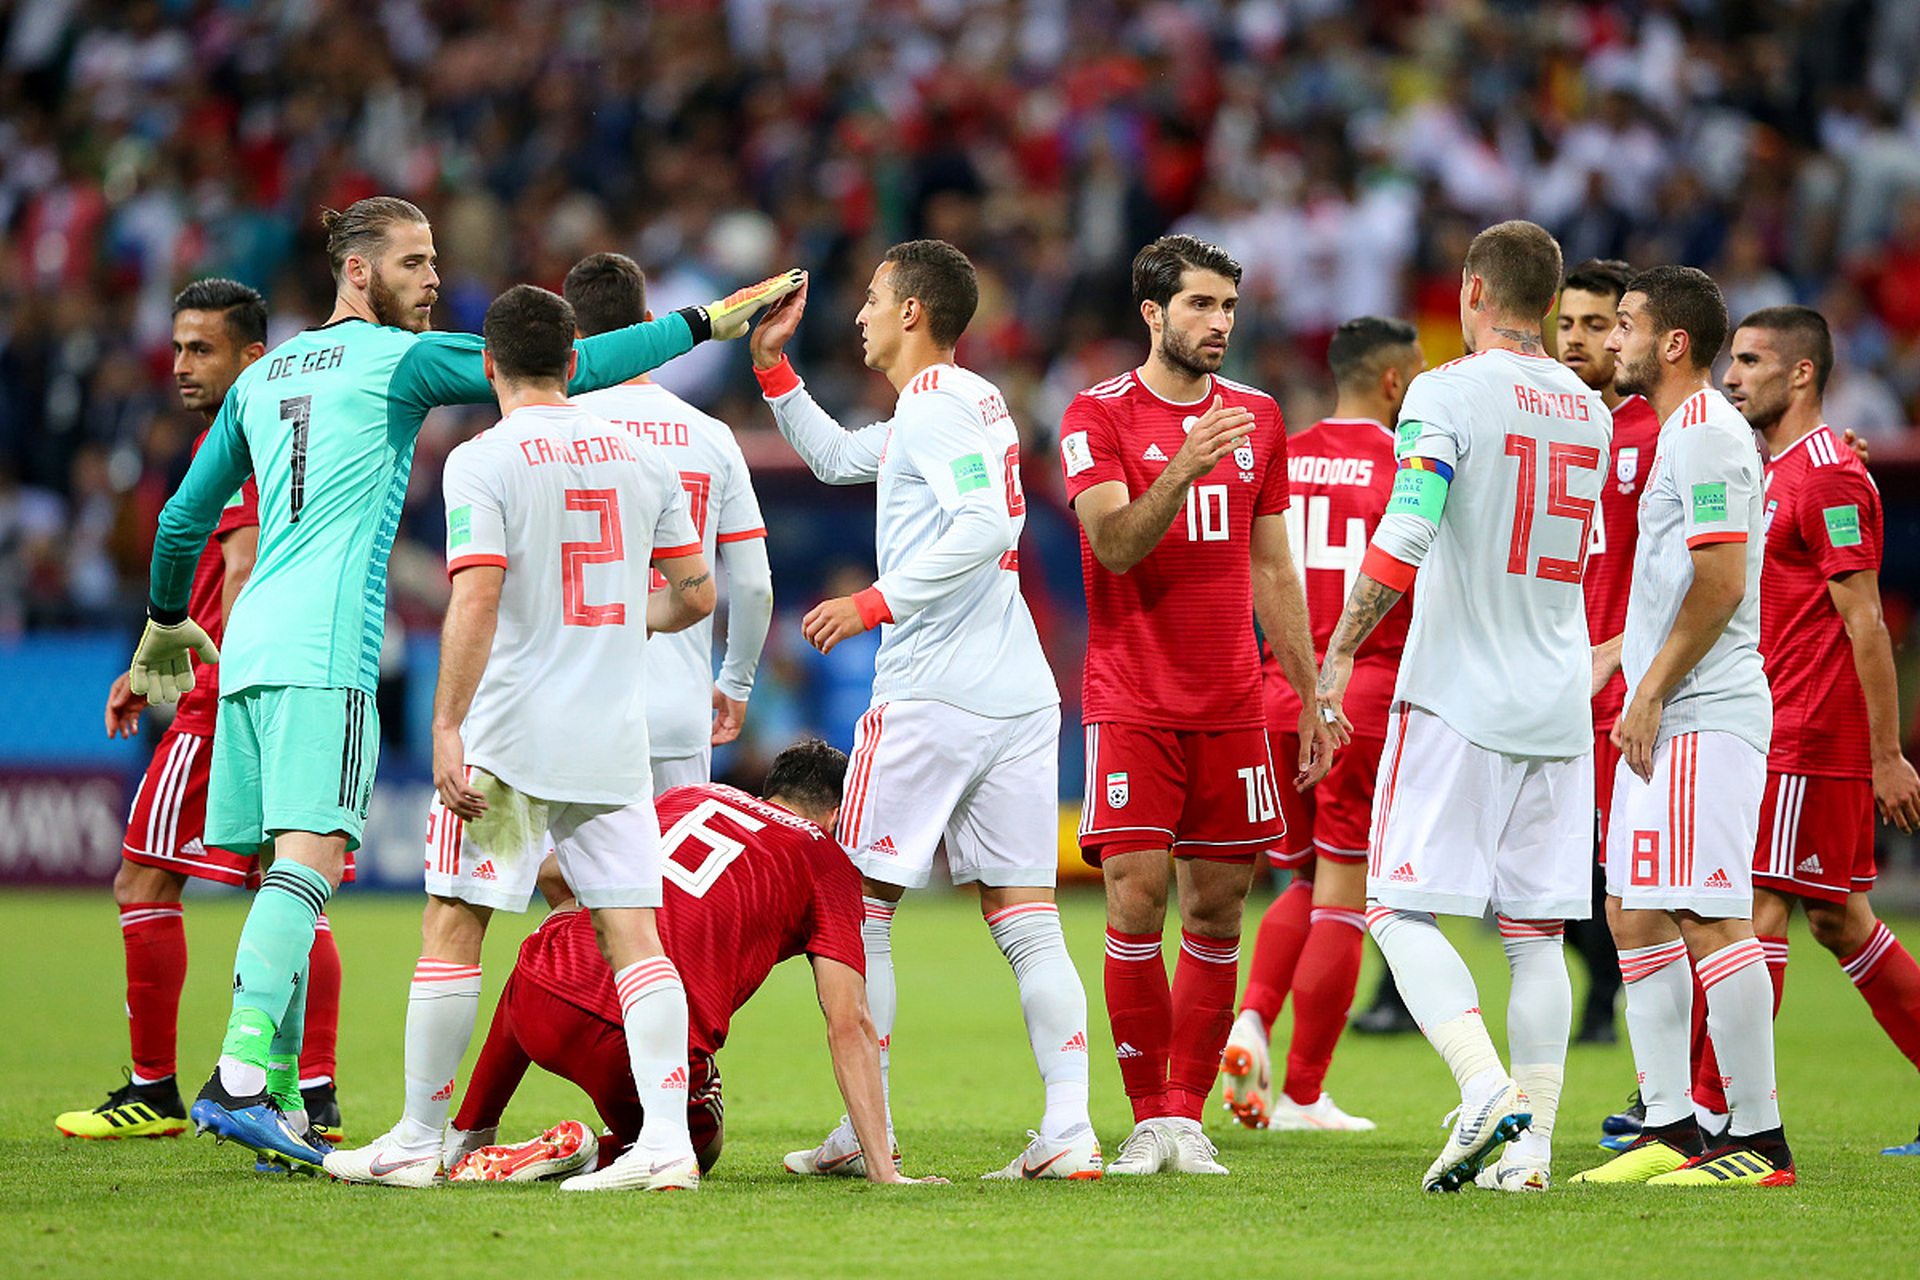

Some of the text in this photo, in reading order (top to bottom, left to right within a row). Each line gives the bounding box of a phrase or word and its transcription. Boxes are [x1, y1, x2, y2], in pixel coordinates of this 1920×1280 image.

[266, 345, 346, 382] DE GEA
[1514, 384, 1590, 422] RAMOS
[279, 394, 313, 524] 1
[1287, 455, 1375, 487] HODDOS
[1186, 484, 1230, 542] 10
[1503, 433, 1601, 585] 15
[561, 487, 626, 628] 2
[1283, 494, 1367, 625] 14
[1237, 764, 1277, 824] 10
[661, 797, 768, 899] 6
[1630, 829, 1660, 887] 8
